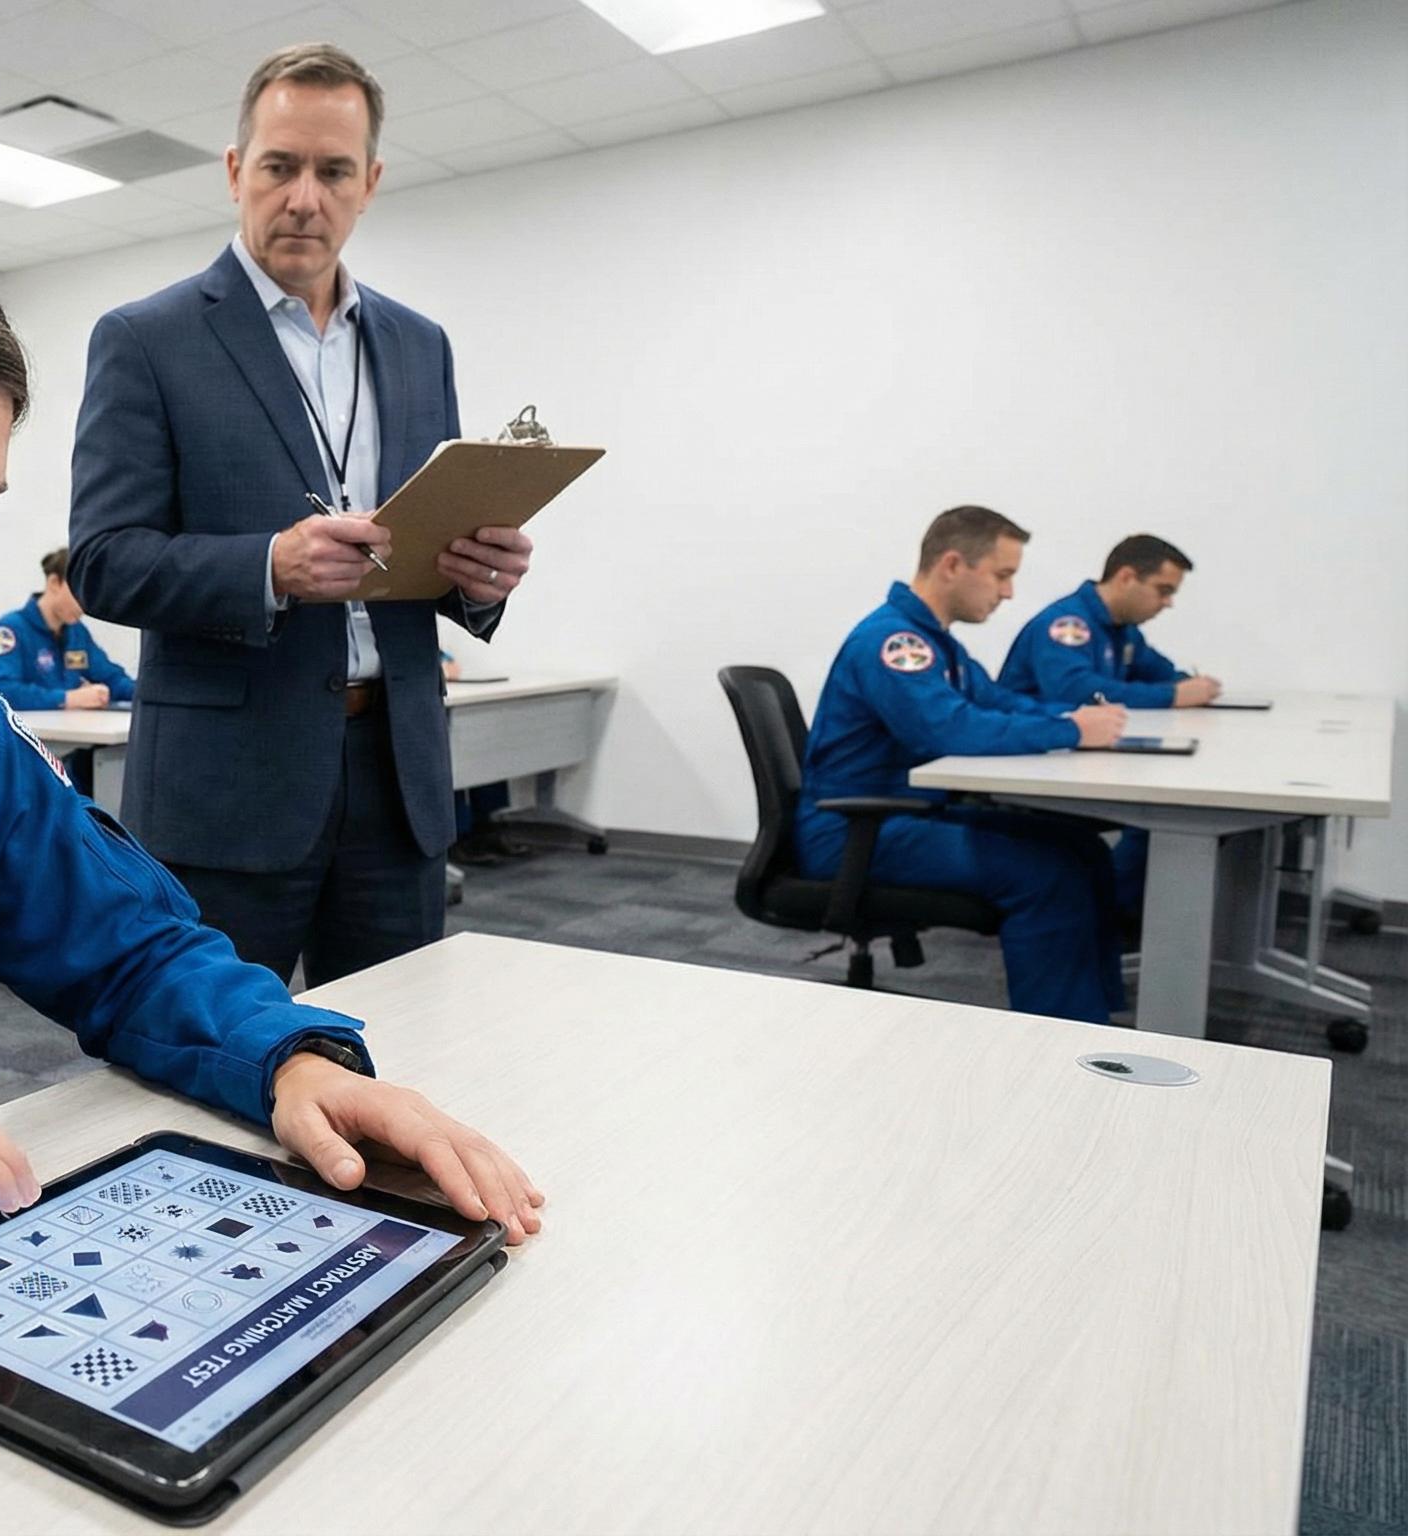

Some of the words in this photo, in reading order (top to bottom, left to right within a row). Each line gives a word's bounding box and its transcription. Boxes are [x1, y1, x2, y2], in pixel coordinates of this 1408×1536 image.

[305, 1243, 382, 1298] ABSTRACT
[223, 1294, 313, 1357] MATCHING
[182, 1354, 232, 1388] TEST
